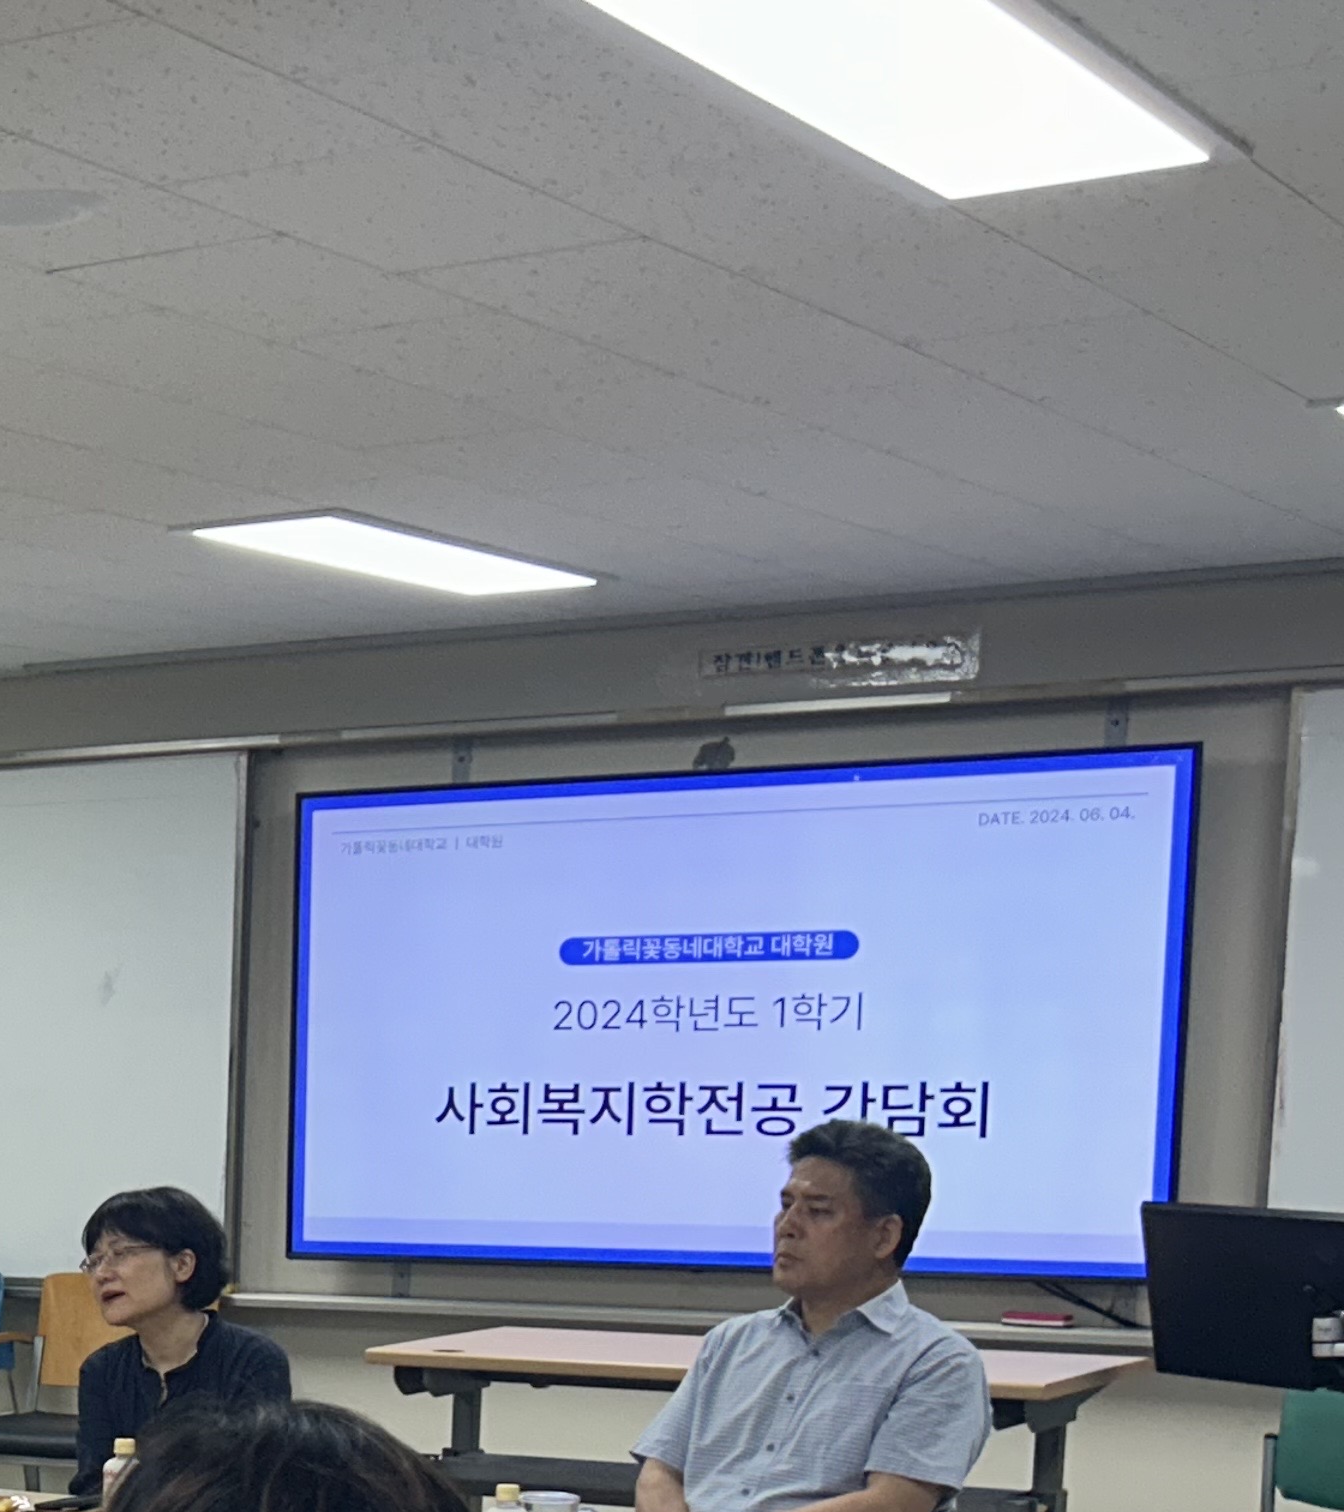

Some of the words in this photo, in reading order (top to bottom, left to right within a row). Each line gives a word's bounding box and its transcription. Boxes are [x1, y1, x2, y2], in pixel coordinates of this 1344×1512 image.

[978, 811, 1024, 826] DATE.
[1079, 807, 1104, 821] 06.
[1109, 806, 1136, 820] 04.
[465, 834, 503, 850] 대학원
[582, 935, 765, 962] 가톨릭꽃동네대학교
[770, 932, 834, 957] 대학원
[553, 994, 759, 1033] 2024학년도
[772, 991, 863, 1032] 1학기
[434, 1080, 804, 1138] 사회복지학전공
